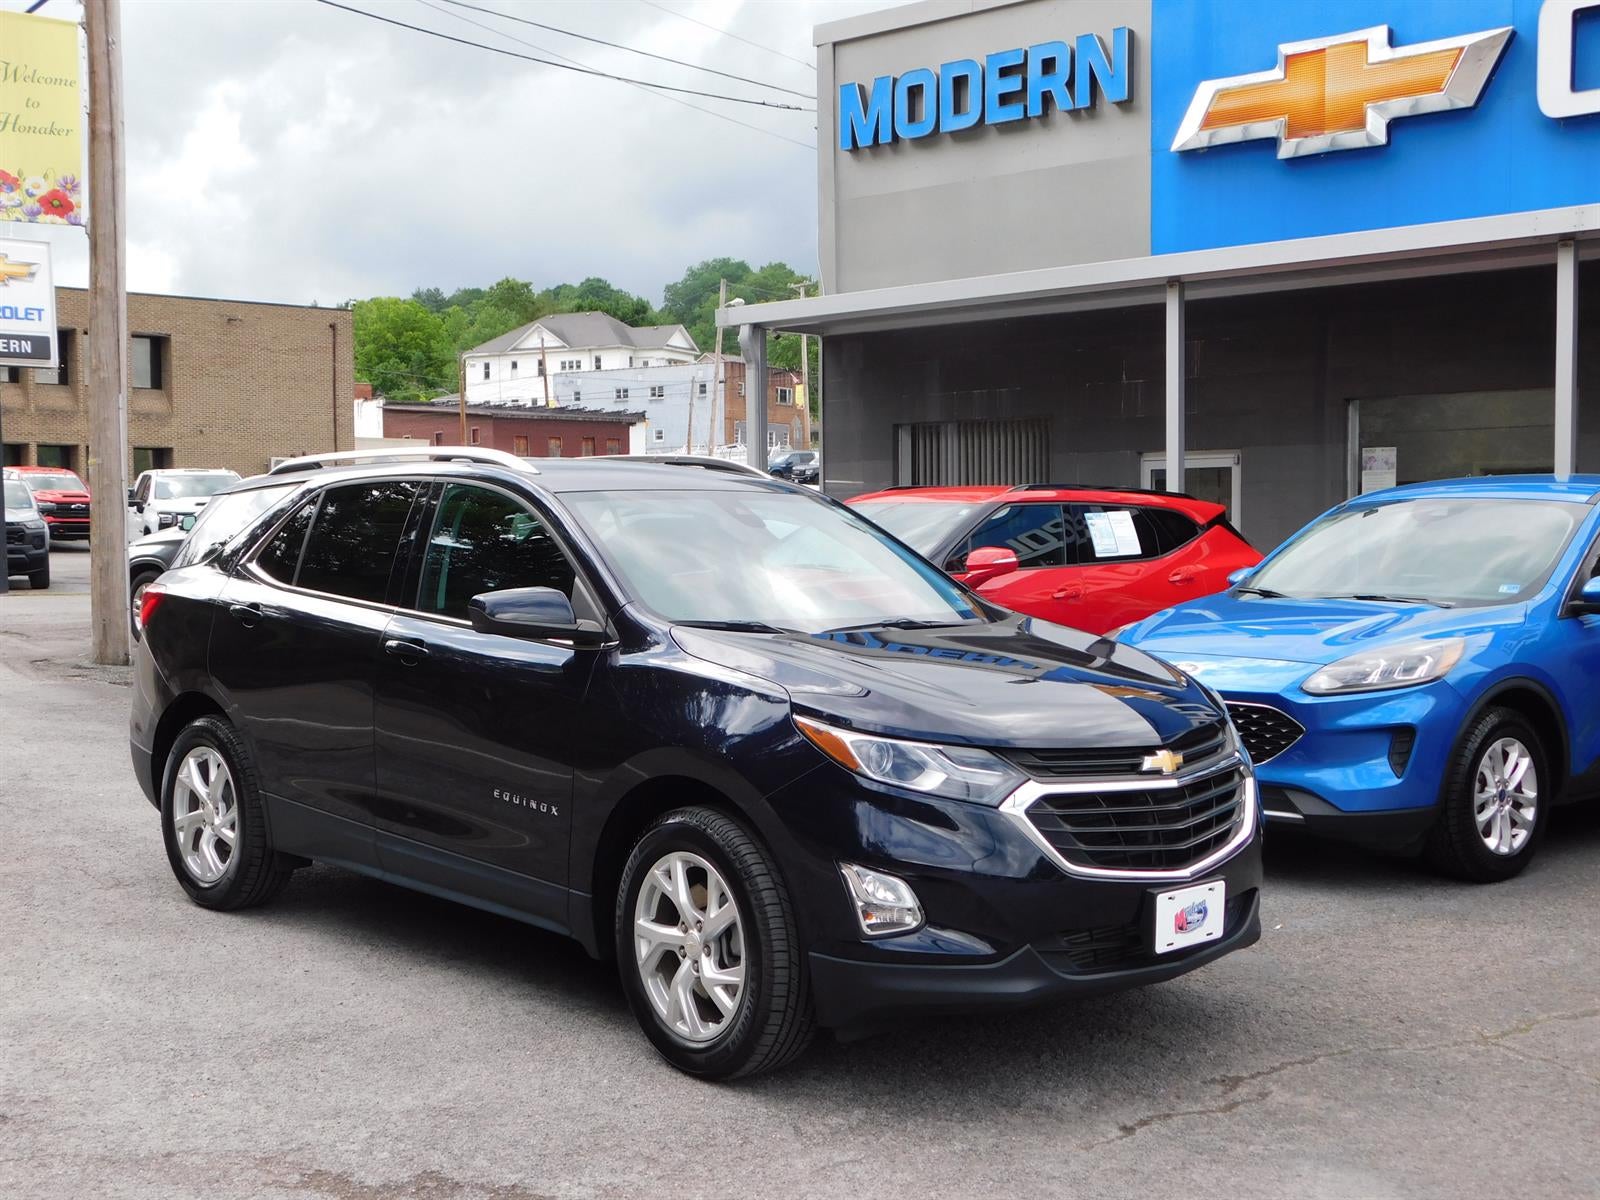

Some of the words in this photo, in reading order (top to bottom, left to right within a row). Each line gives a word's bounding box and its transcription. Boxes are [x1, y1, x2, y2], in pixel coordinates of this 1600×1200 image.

[0, 60, 77, 87] Welcome
[839, 26, 1132, 151] MODERN
[25, 97, 40, 109] to
[0, 112, 73, 136] Honaker
[493, 789, 558, 816] EQUINOX
